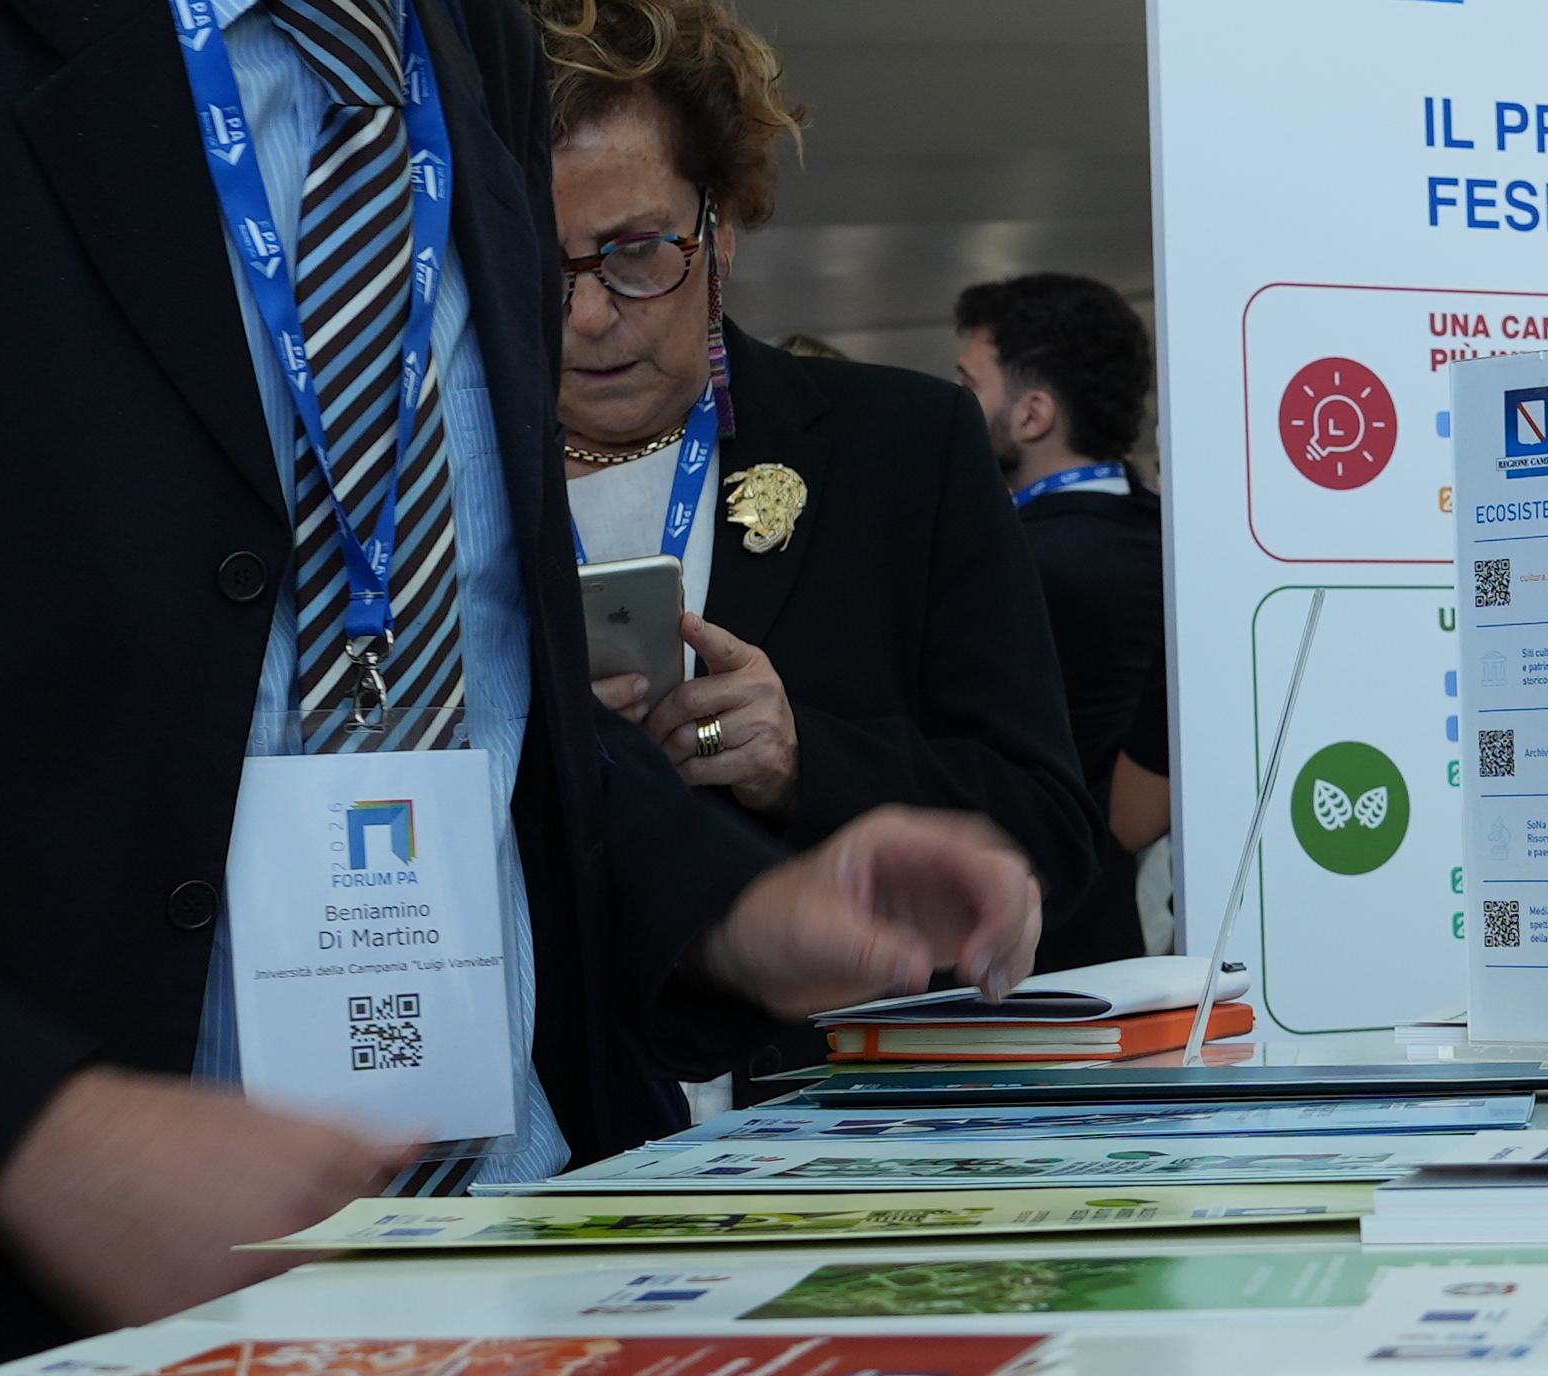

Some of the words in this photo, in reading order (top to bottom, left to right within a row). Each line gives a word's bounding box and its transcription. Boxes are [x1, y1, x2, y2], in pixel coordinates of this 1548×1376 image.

[1425, 97, 1474, 150] IL
[1429, 313, 1491, 338] UNA
[1497, 457, 1529, 470] REGIONE
[332, 873, 393, 888] FORUM
[397, 871, 419, 885] PA
[325, 902, 431, 922] Beniamino
[318, 930, 343, 950] Di
[352, 927, 440, 949] Martino
[1530, 933, 1548, 943] della
[315, 964, 345, 977] della
[348, 962, 408, 975] Campania
